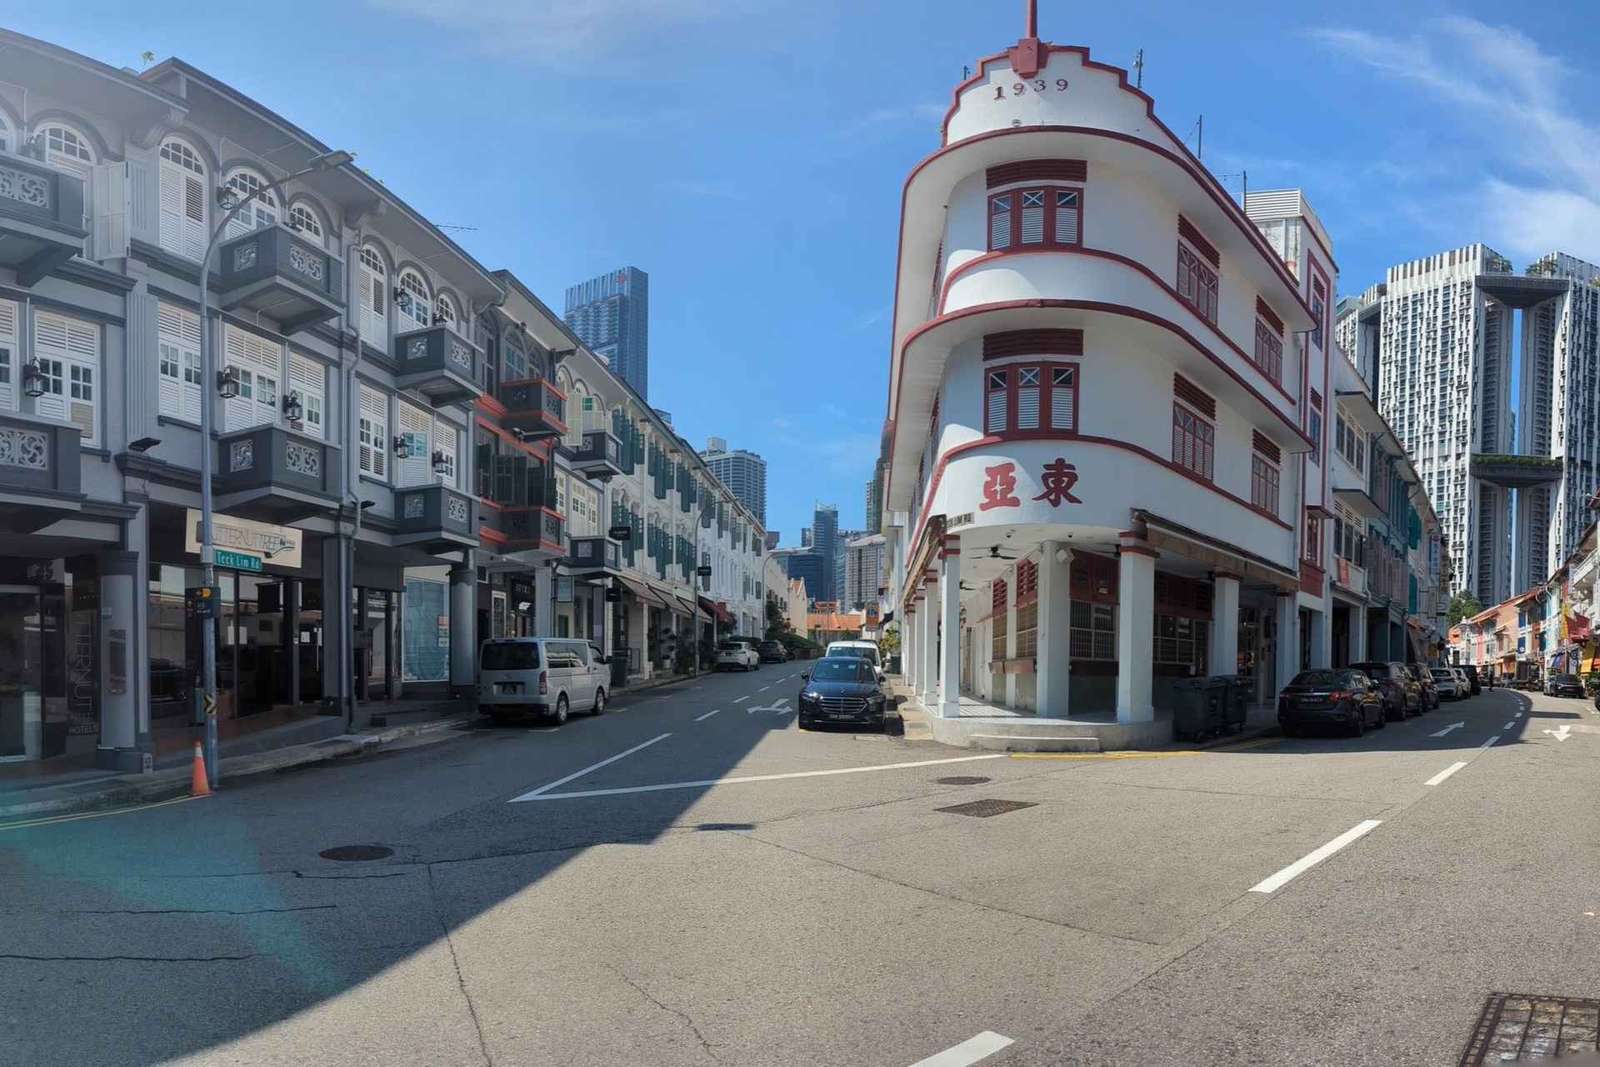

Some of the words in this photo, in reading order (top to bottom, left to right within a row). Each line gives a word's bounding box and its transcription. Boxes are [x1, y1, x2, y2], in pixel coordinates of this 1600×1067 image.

[993, 78, 1069, 101] 1939
[217, 551, 235, 566] Teck
[236, 554, 249, 568] Lim
[251, 557, 261, 569] Rd
